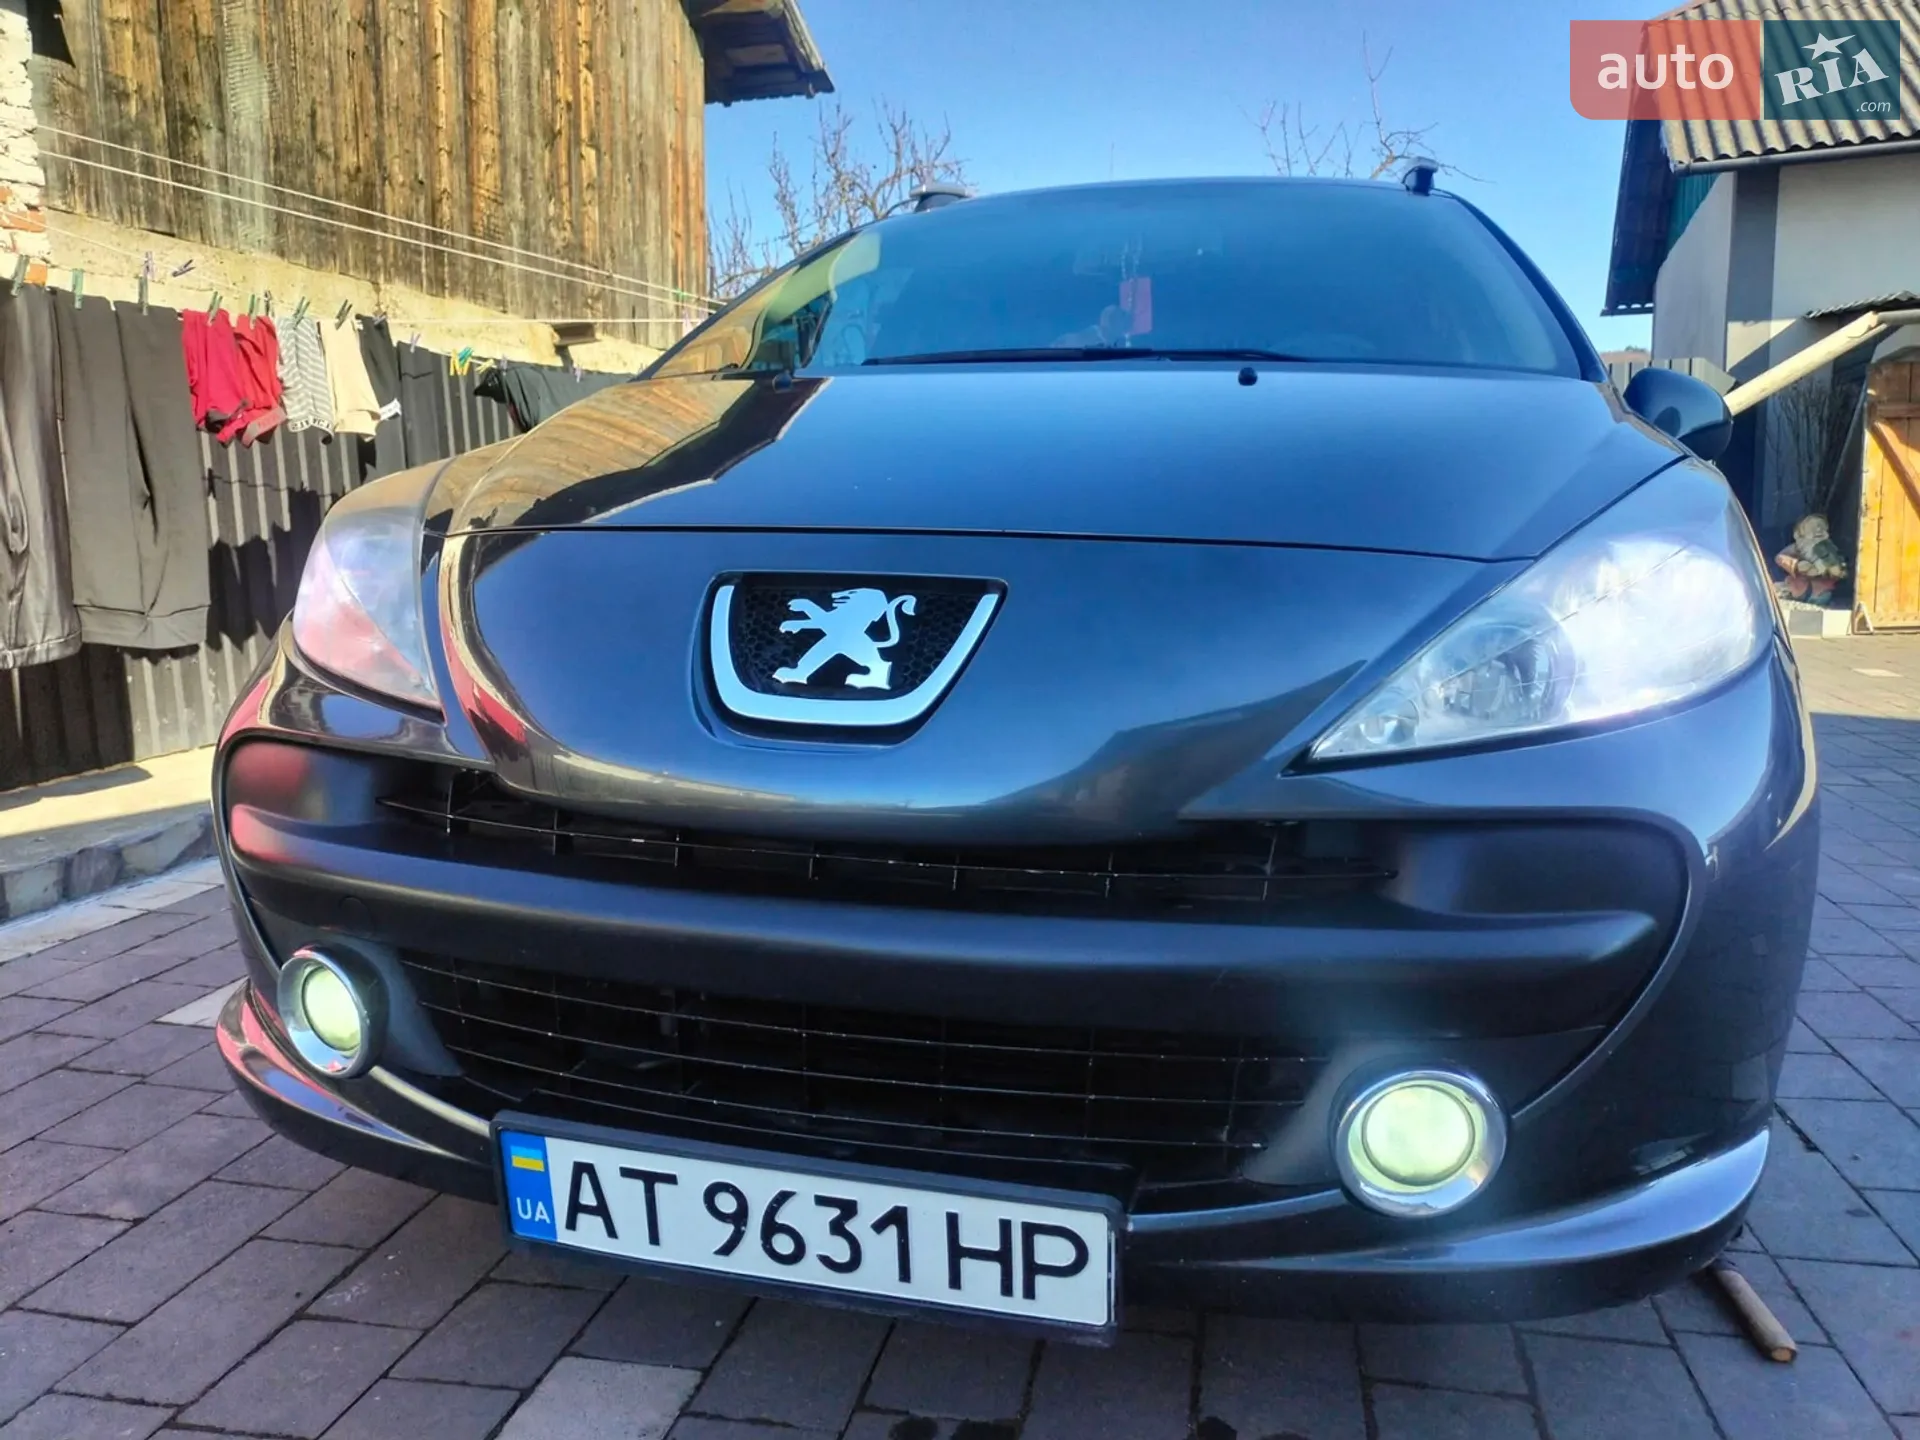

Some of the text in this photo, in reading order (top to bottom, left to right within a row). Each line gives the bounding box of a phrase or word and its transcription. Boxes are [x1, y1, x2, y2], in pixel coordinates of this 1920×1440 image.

[516, 1197, 551, 1224] UA
[565, 1160, 1090, 1300] AT 9631 HP
